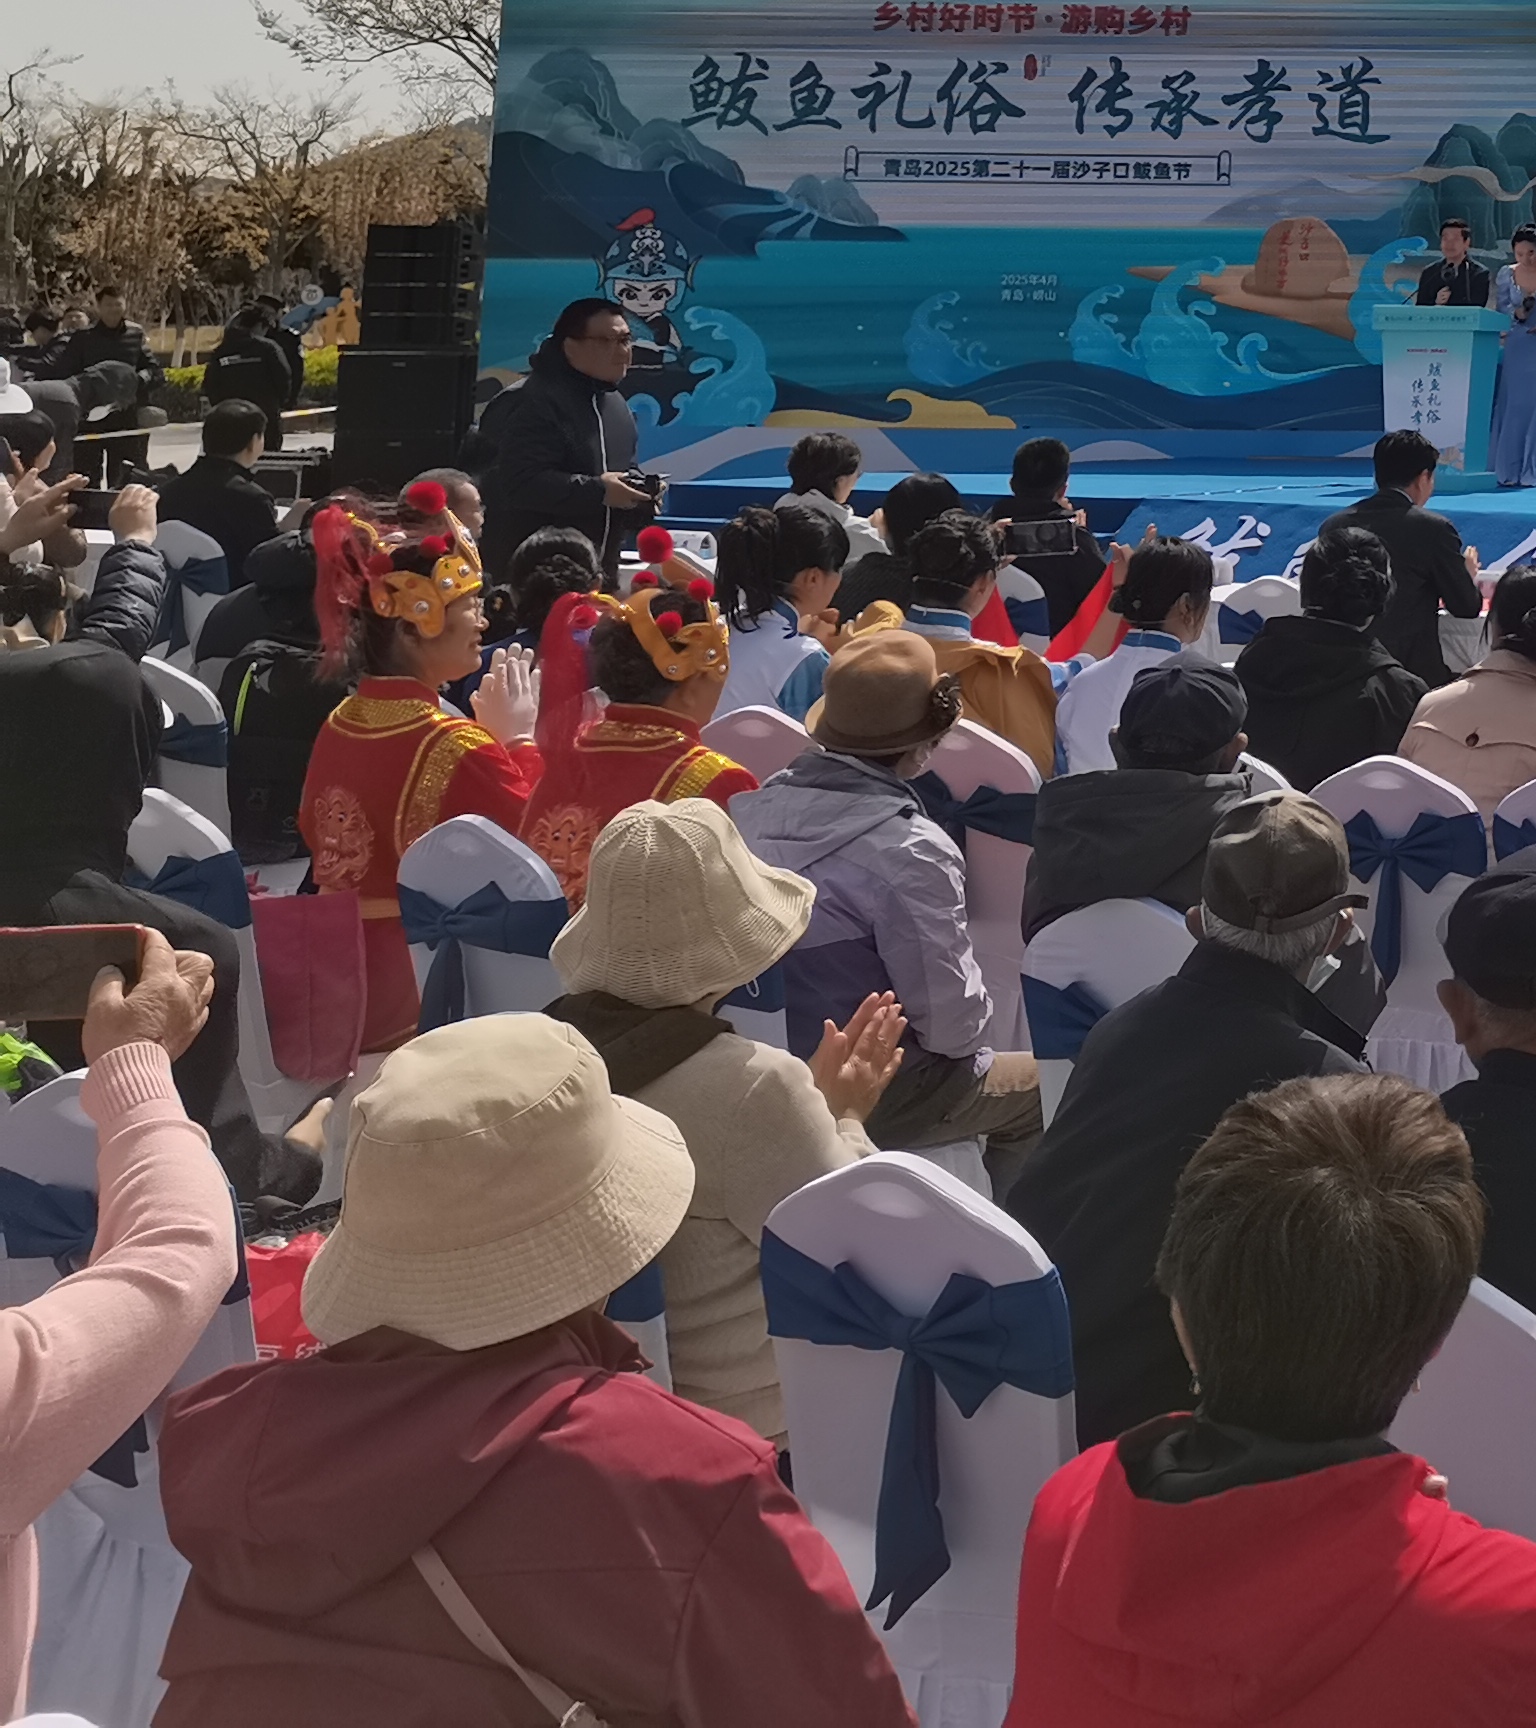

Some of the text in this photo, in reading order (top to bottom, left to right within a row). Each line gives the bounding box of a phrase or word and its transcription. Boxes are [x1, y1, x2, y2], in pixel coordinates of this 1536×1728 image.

[872, 2, 1192, 36] 乡村好时节·游购乡村
[680, 51, 1391, 145] 鲅鱼礼俗 传承孝道
[883, 157, 1193, 181] 青岛2025第二十一届沙子口鲅鱼节
[1001, 273, 1058, 286] 2025年4月
[1410, 378, 1425, 433] 传承孝
